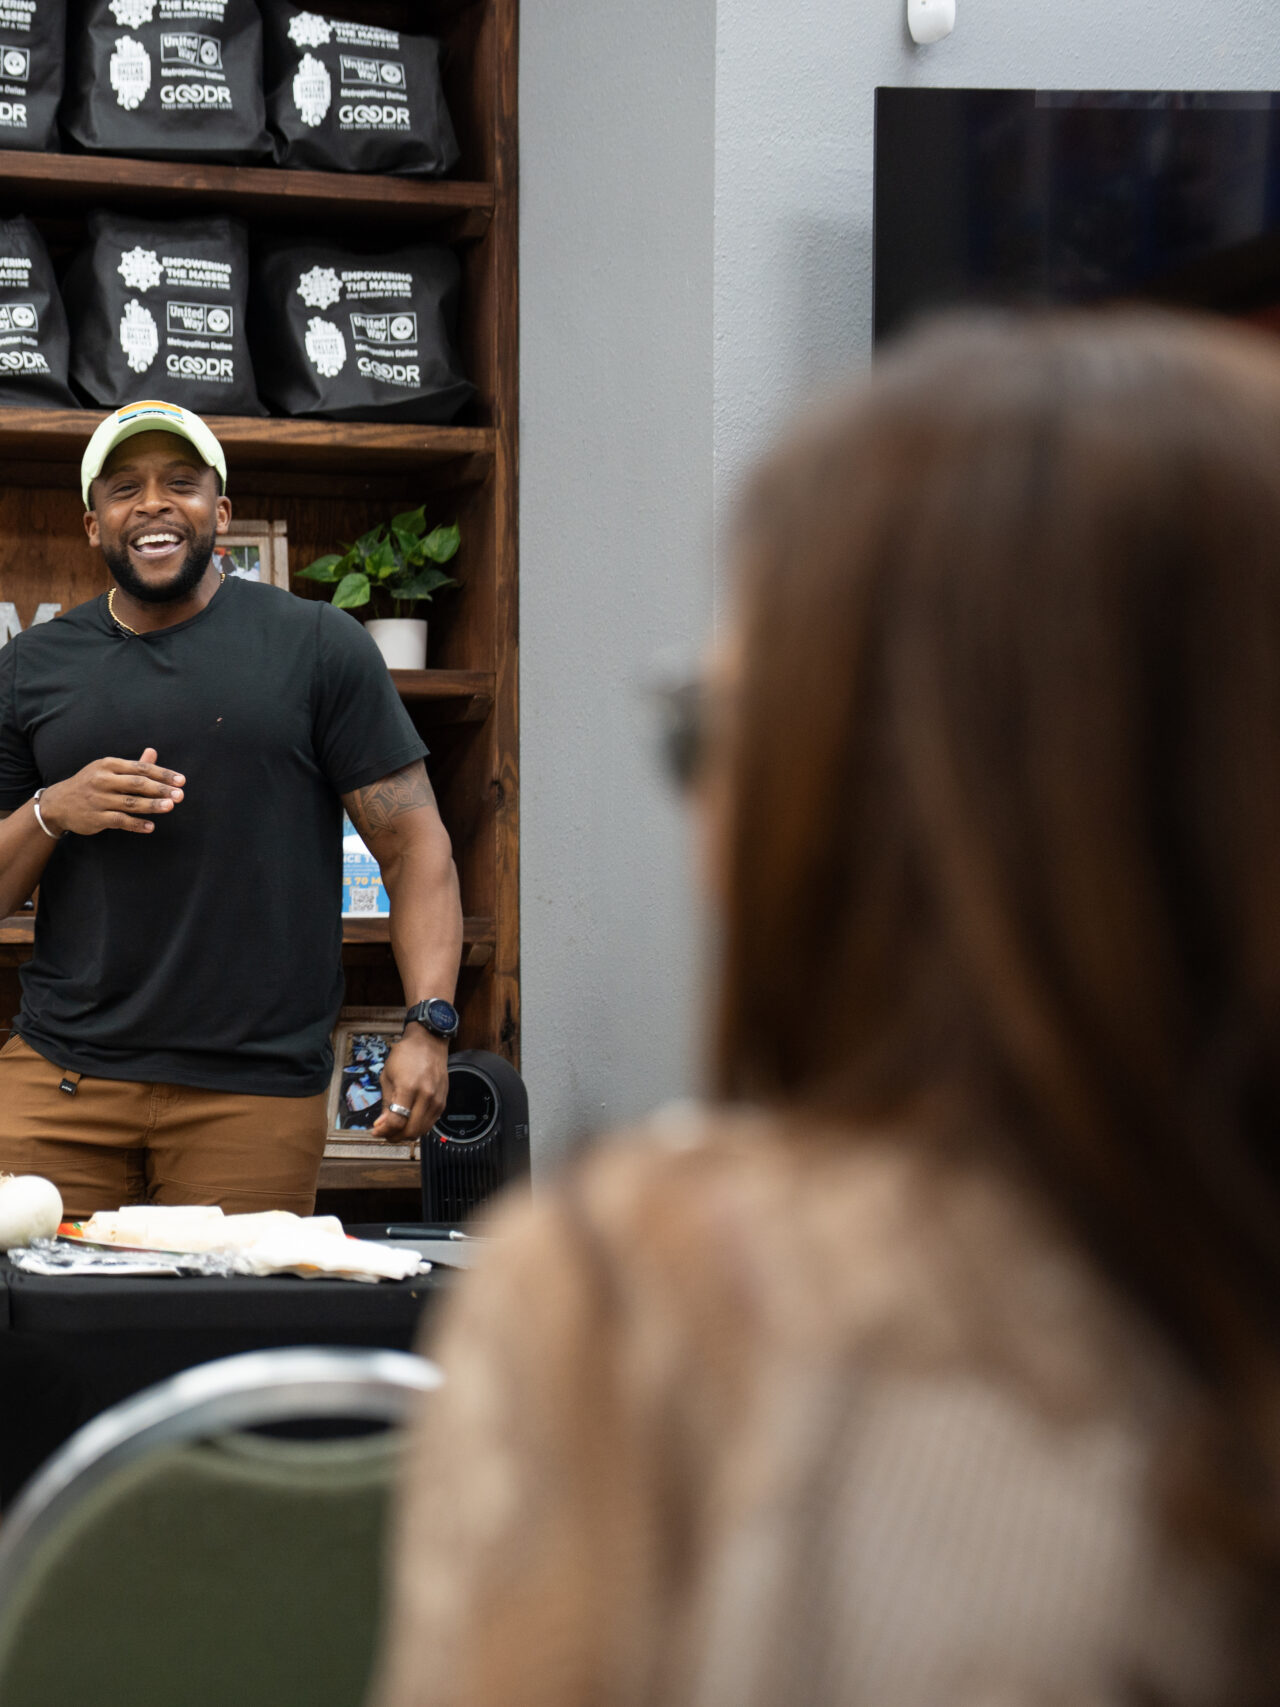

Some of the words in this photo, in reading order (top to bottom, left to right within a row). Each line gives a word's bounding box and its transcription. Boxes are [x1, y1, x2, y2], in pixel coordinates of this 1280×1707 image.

[162, 256, 232, 274] EMPOWERING
[166, 268, 187, 279] THE
[188, 269, 230, 283] MASSES
[341, 270, 413, 283] EMPOWERING
[345, 281, 367, 291] THE
[368, 281, 411, 291] MASSES
[169, 305, 203, 319] United
[182, 317, 204, 332] Way
[353, 316, 387, 330] United
[366, 328, 387, 342] Way
